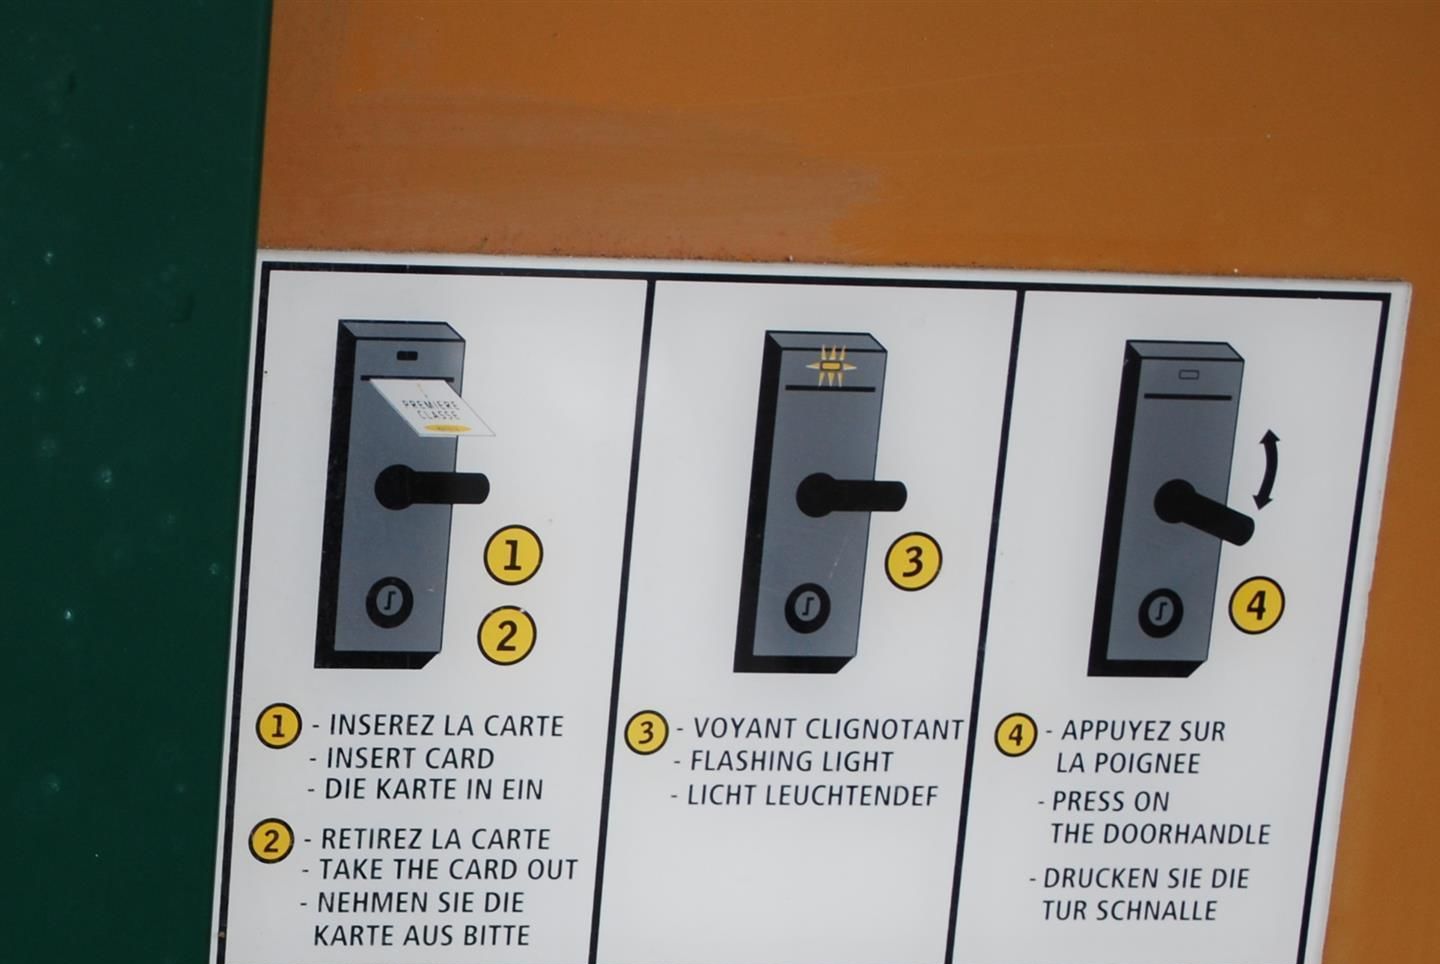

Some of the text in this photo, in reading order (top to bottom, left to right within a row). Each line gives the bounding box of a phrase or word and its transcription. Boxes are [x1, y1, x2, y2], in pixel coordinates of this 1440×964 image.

[503, 539, 522, 571] 1
[902, 546, 923, 578] 3
[1246, 590, 1266, 620] 4
[497, 620, 518, 651] 2
[271, 714, 285, 738] 1
[330, 713, 435, 736] INSEREZ
[444, 714, 474, 737] LA
[484, 714, 564, 737] CARTE
[638, 721, 654, 744] 3
[693, 716, 798, 739] VOYANT
[805, 717, 965, 741] CLIGNOTANT
[1009, 724, 1023, 746] 4
[1060, 719, 1172, 742] APPUYEZ
[1179, 720, 1226, 742] SUR
[327, 746, 417, 769] INSERT
[425, 747, 495, 770] CARD
[690, 749, 813, 772] FLASHING
[822, 750, 895, 773] LIGHT
[1056, 752, 1201, 774] LA POIGNEE
[325, 777, 367, 800] DIE
[376, 777, 457, 800] KARTE
[466, 778, 493, 800] IN
[502, 778, 543, 801] EIN
[687, 783, 757, 806] LICHT
[765, 784, 939, 807] LEUCHTENDEF
[1052, 790, 1125, 812] PRESS
[1134, 790, 1170, 813] ON
[263, 829, 279, 853] 2
[321, 827, 423, 850] RETIREZ
[431, 828, 462, 850] LA
[471, 828, 551, 850] CARTE
[1051, 822, 1271, 845] THE DOORHANDLE
[319, 858, 384, 880] TAKE
[393, 858, 440, 880] THE
[448, 858, 518, 880] CARD
[527, 858, 579, 881] OUT
[1043, 867, 1159, 889] DRUCKEN
[1167, 867, 1203, 889] SIE
[1211, 868, 1250, 889] DIE
[317, 891, 428, 913] NEHMEN
[437, 891, 475, 914] SIE
[484, 891, 525, 913] DIE
[1042, 899, 1218, 921] TUR SCHNALLE
[314, 924, 531, 947] KARTE AUS BITTE
